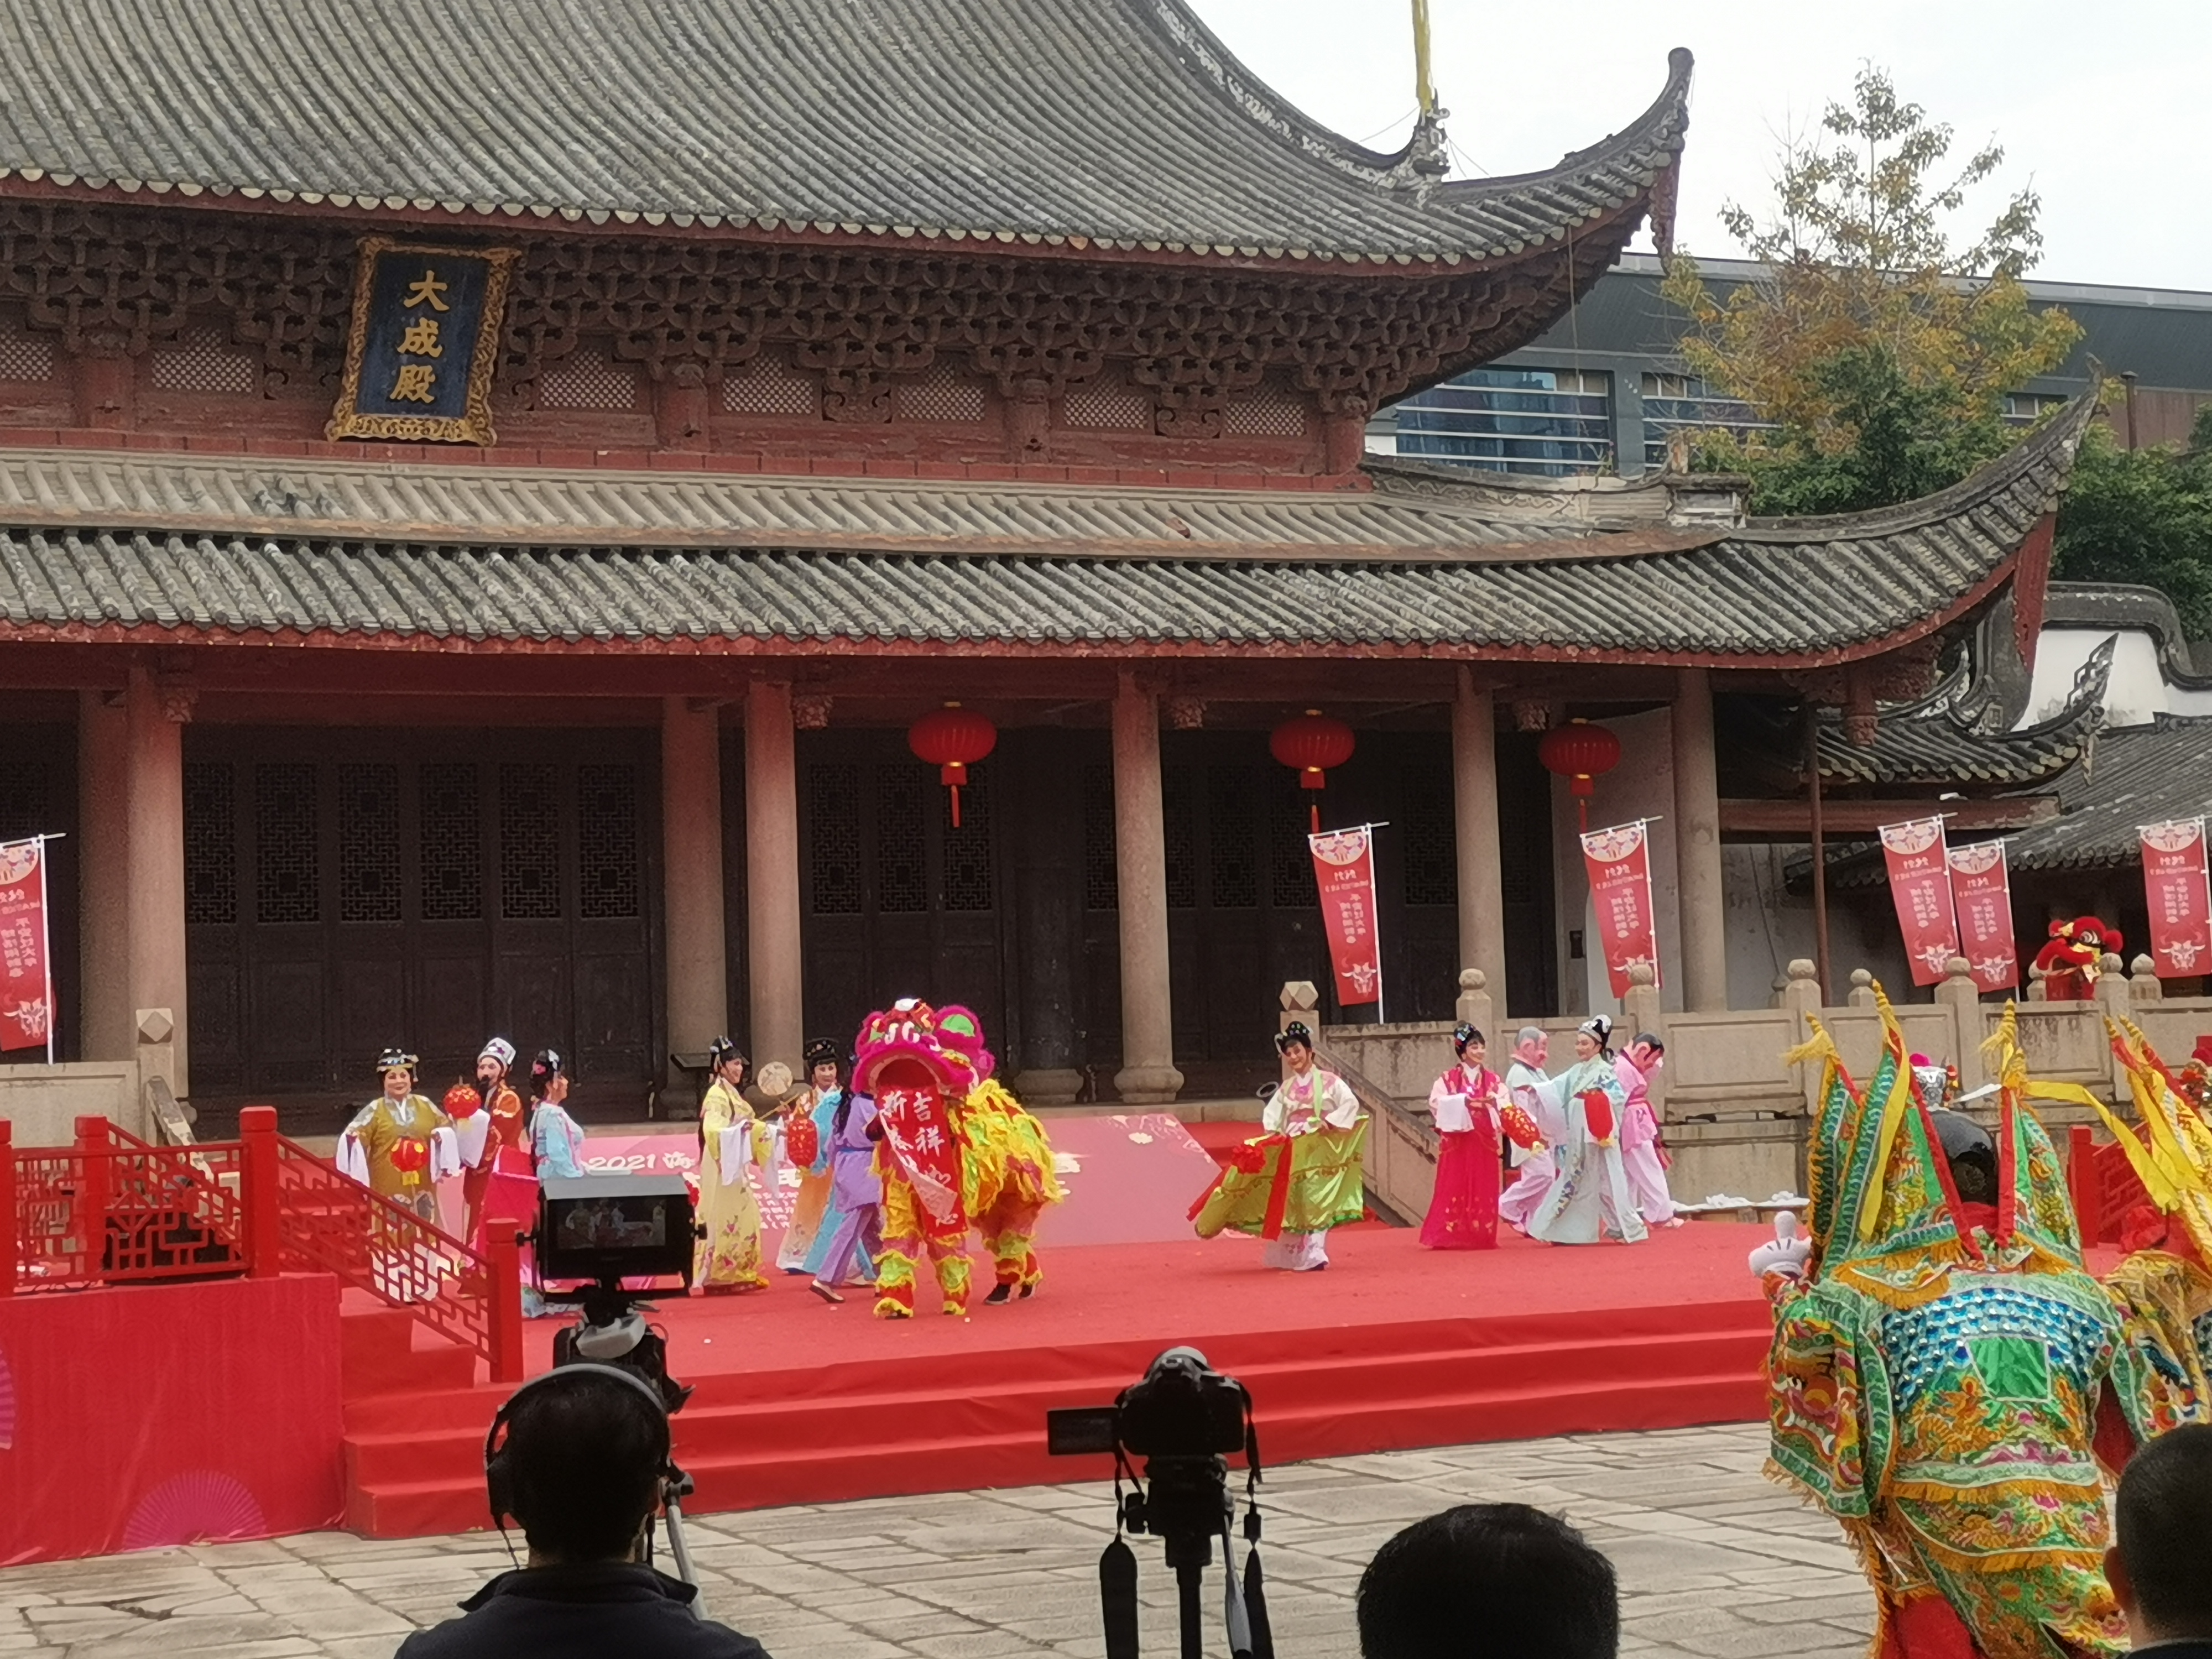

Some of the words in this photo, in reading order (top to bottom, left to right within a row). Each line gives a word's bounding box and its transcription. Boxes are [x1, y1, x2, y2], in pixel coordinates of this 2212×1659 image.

[389, 270, 450, 404] 大成殿
[588, 1154, 656, 1170] 2021
